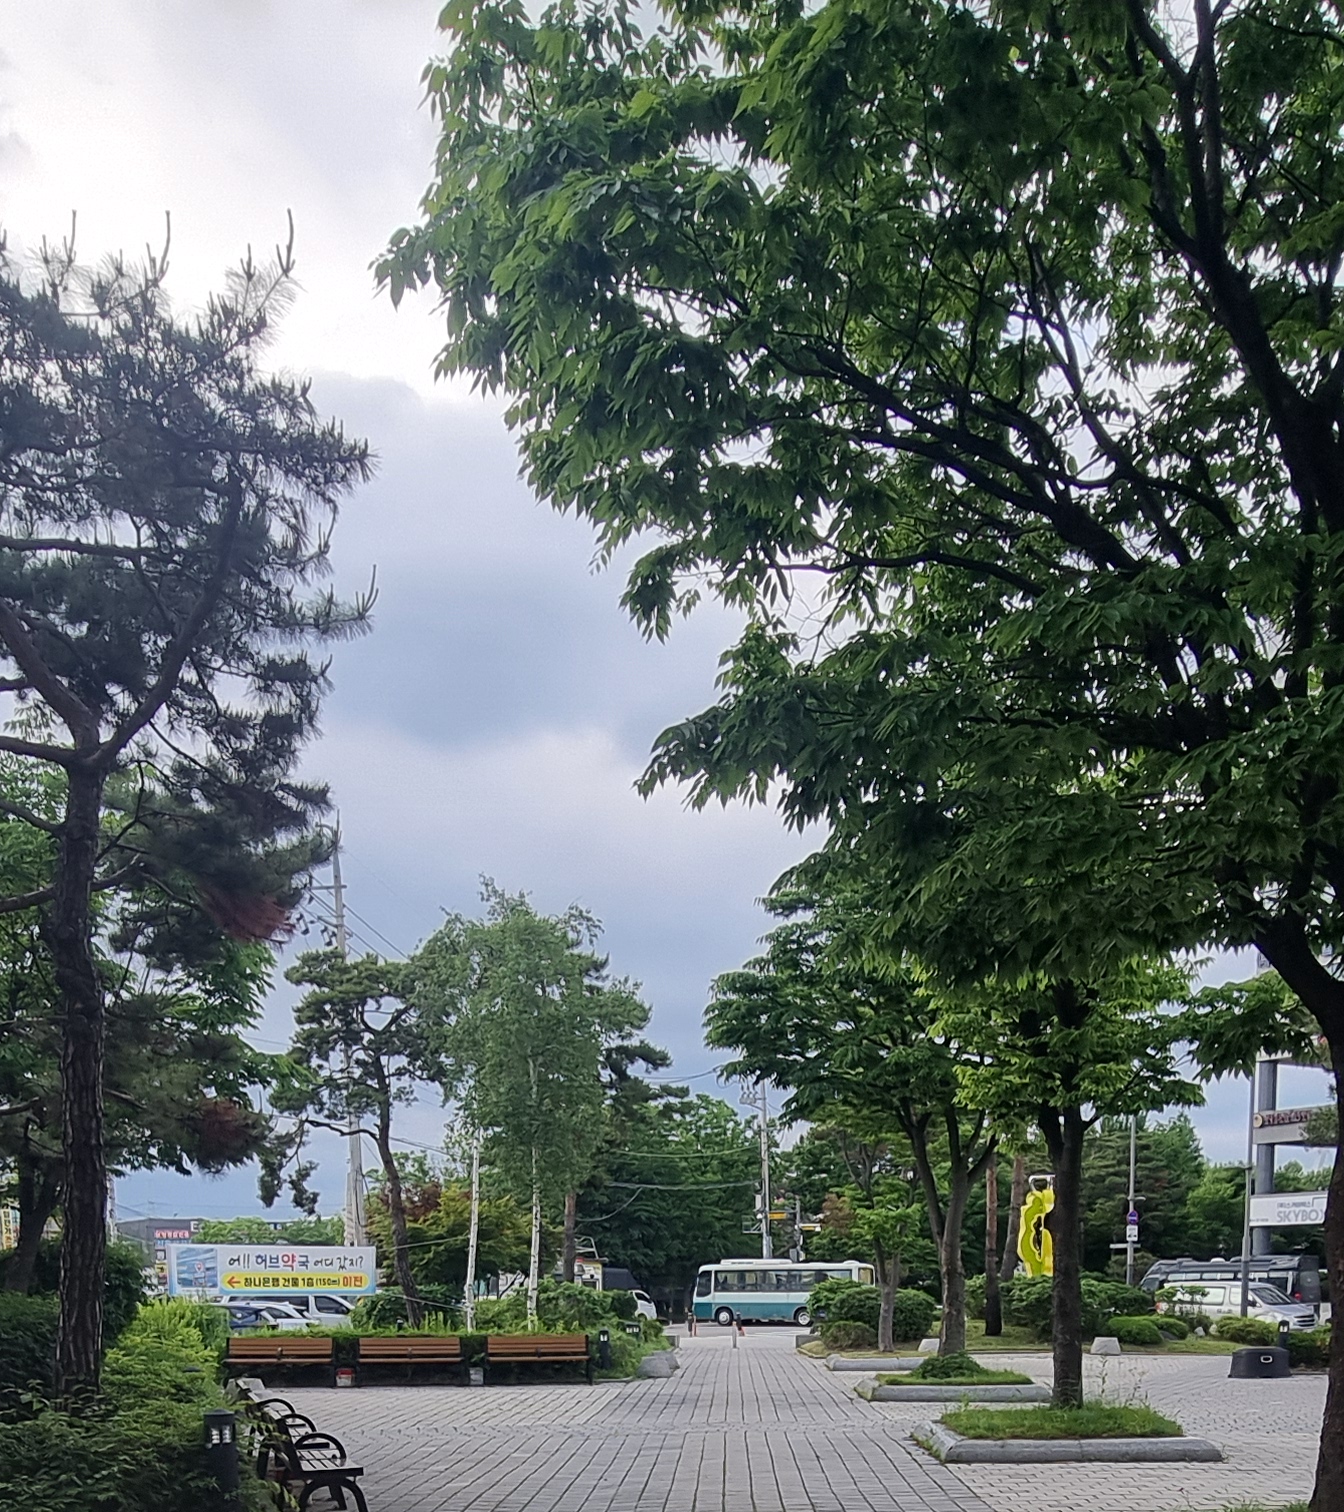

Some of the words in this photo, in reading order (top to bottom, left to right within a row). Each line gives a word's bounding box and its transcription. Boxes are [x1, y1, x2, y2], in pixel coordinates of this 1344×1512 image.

[255, 1253, 310, 1272] 허브약국
[313, 1256, 335, 1269] 어디
[243, 1276, 281, 1288] 하나은행
[282, 1276, 300, 1288] 건물
[342, 1275, 364, 1288] 이전
